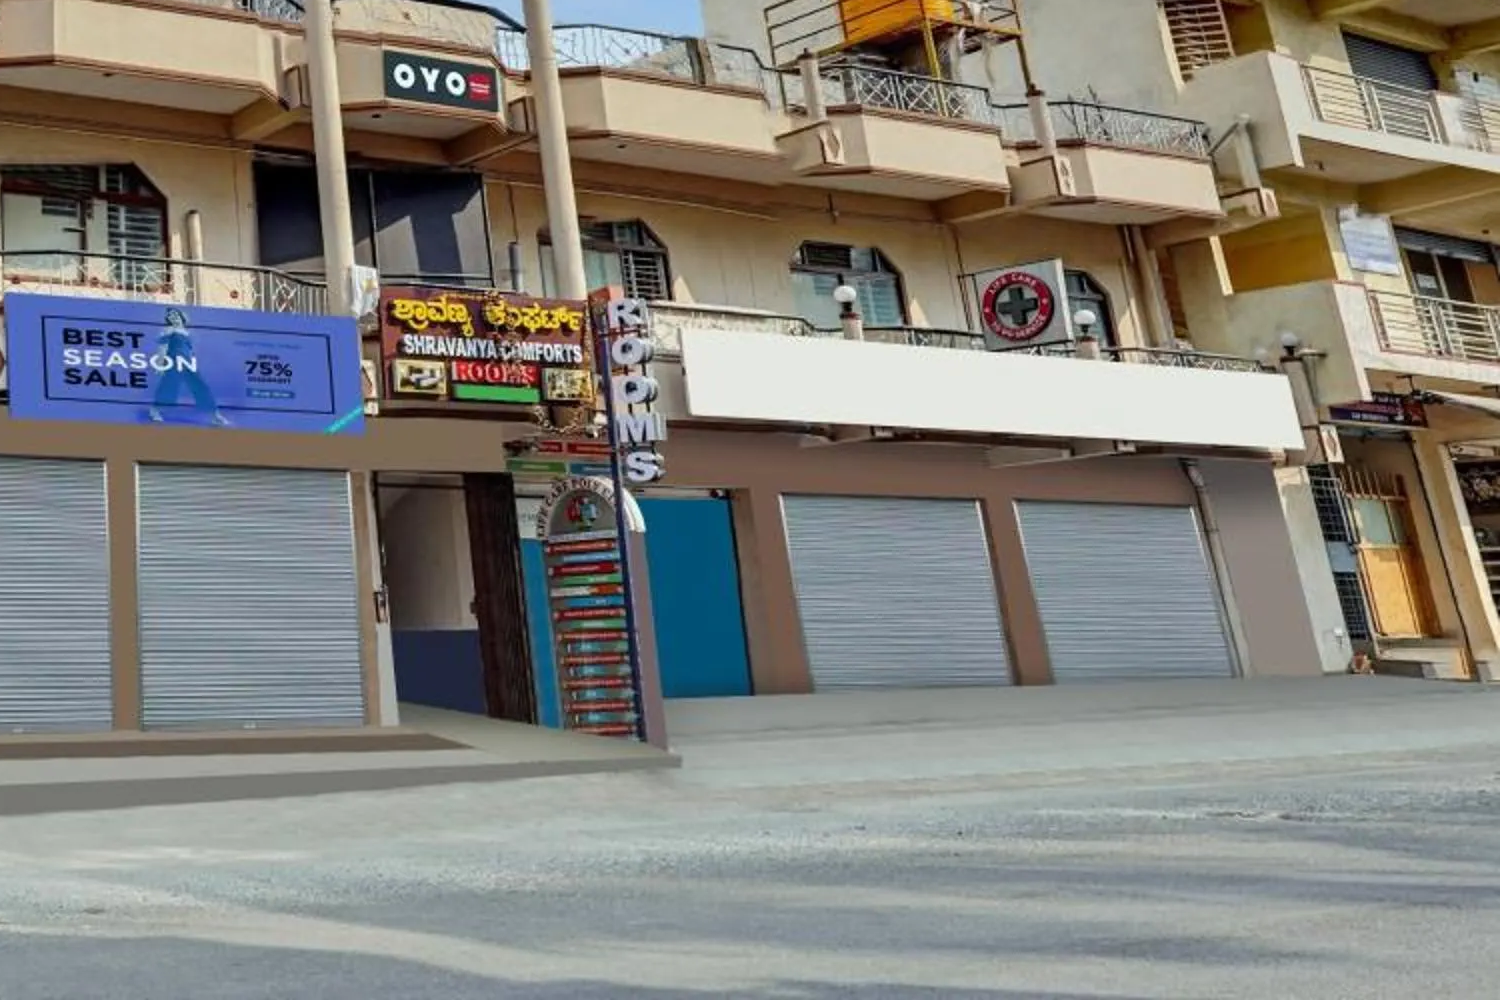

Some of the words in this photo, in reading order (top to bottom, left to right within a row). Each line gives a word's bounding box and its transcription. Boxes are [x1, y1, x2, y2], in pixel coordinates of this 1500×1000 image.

[393, 63, 466, 97] OYO
[62, 327, 145, 349] BEST
[403, 333, 497, 359] SHRAVANYA
[63, 348, 197, 373] SEASON
[244, 361, 292, 377] 75%
[64, 367, 148, 389] SALE
[608, 297, 667, 482] ROOMS
